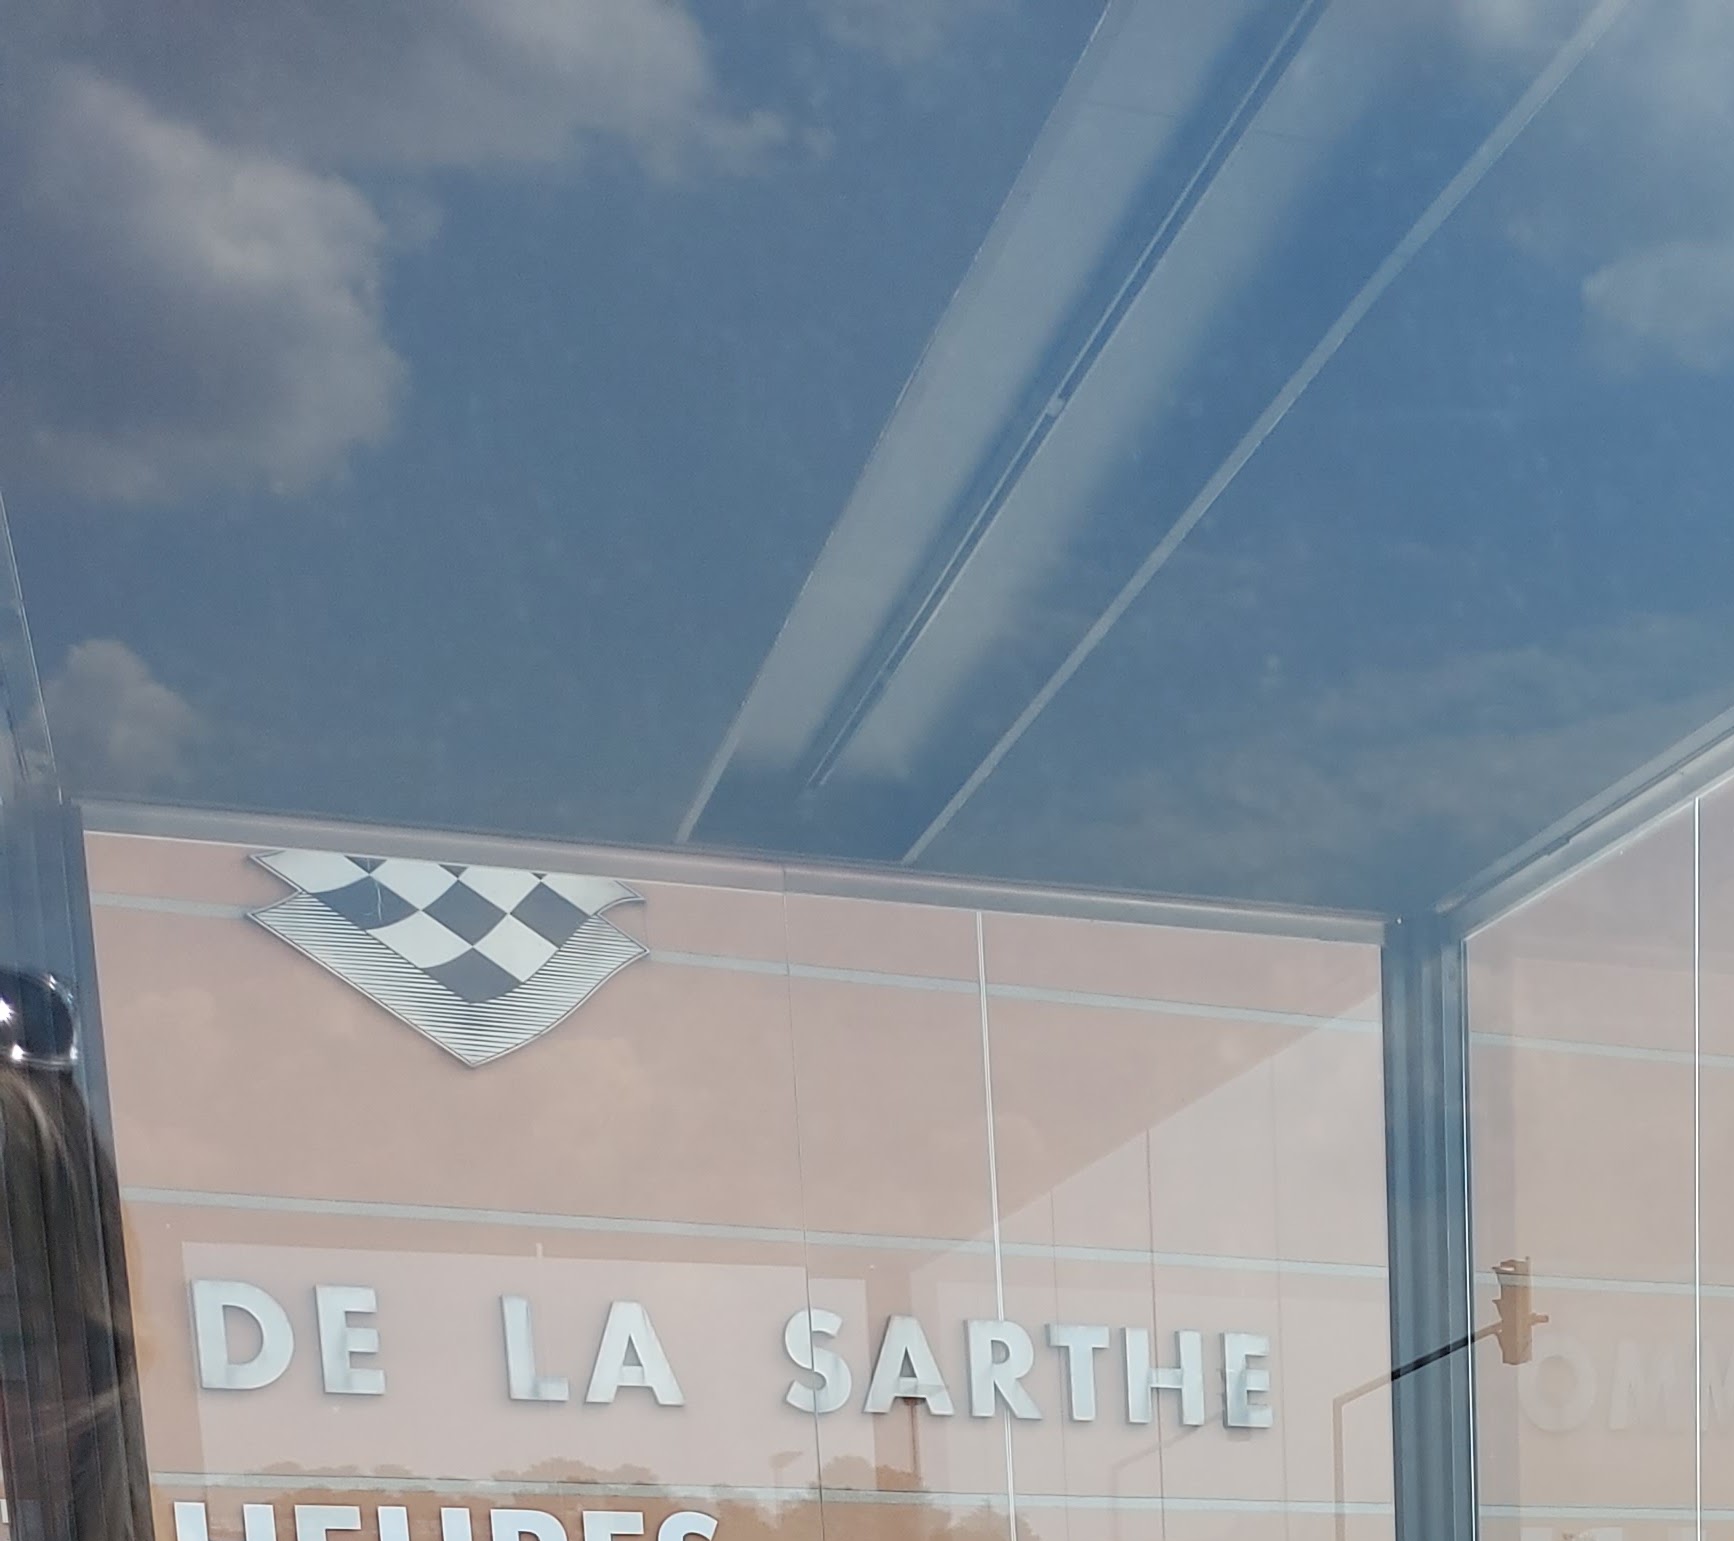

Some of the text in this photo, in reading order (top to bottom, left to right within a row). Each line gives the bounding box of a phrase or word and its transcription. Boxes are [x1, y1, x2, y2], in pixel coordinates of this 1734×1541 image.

[190, 1278, 1276, 1430] DE LA SARTHE
